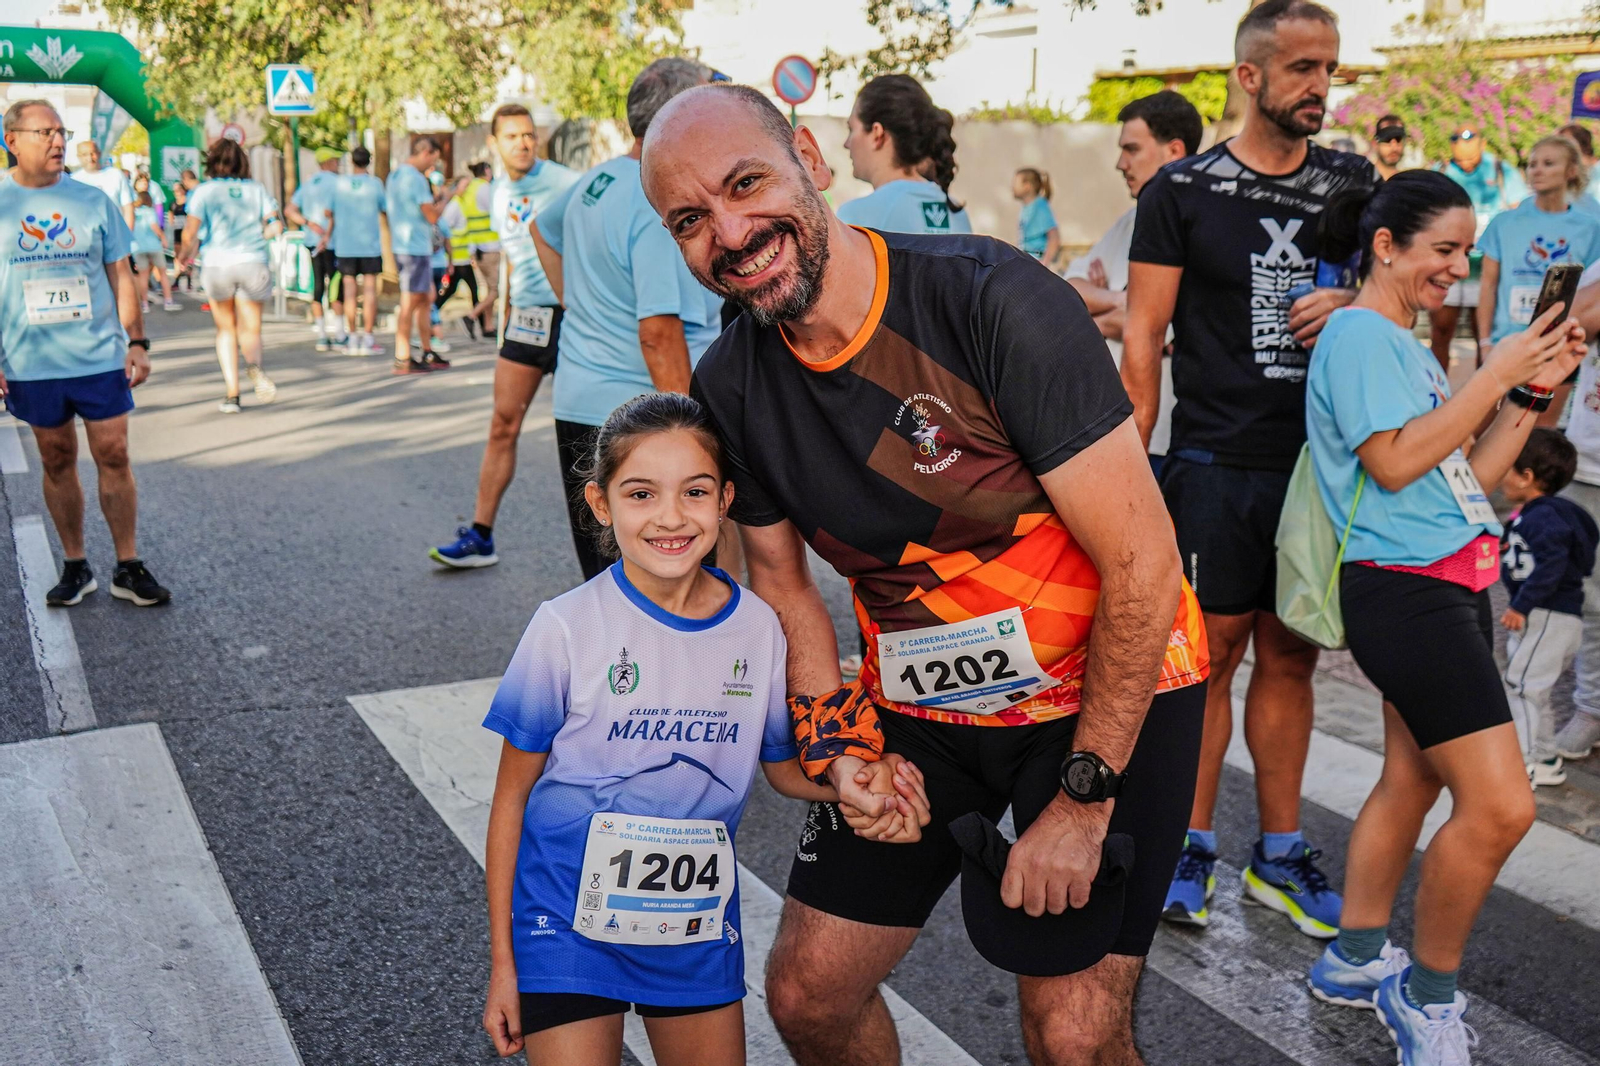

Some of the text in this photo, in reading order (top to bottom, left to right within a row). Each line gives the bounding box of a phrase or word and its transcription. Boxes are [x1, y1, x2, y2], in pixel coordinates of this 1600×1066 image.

[46, 290, 70, 304] 78
[894, 393, 952, 426] CLUB DE ATLETISMO
[913, 448, 962, 474] PELIGROS
[908, 626, 988, 647] CARRERA-MARCHA
[898, 648, 931, 657] SOLIDARIA
[932, 643, 959, 652] ASPACE
[960, 634, 996, 647] GRANADA
[899, 649, 1019, 696] 1202
[722, 681, 754, 690] Ayuntamiento
[726, 689, 752, 697] Maracena
[960, 690, 983, 698] ARANDA
[629, 708, 728, 718] CLUB DE ATLETISMO
[607, 719, 739, 744] MARACENA
[619, 832, 661, 844] SOLIDARIA
[638, 824, 712, 836] CARRERA-MARCHA
[609, 849, 720, 893] 1204
